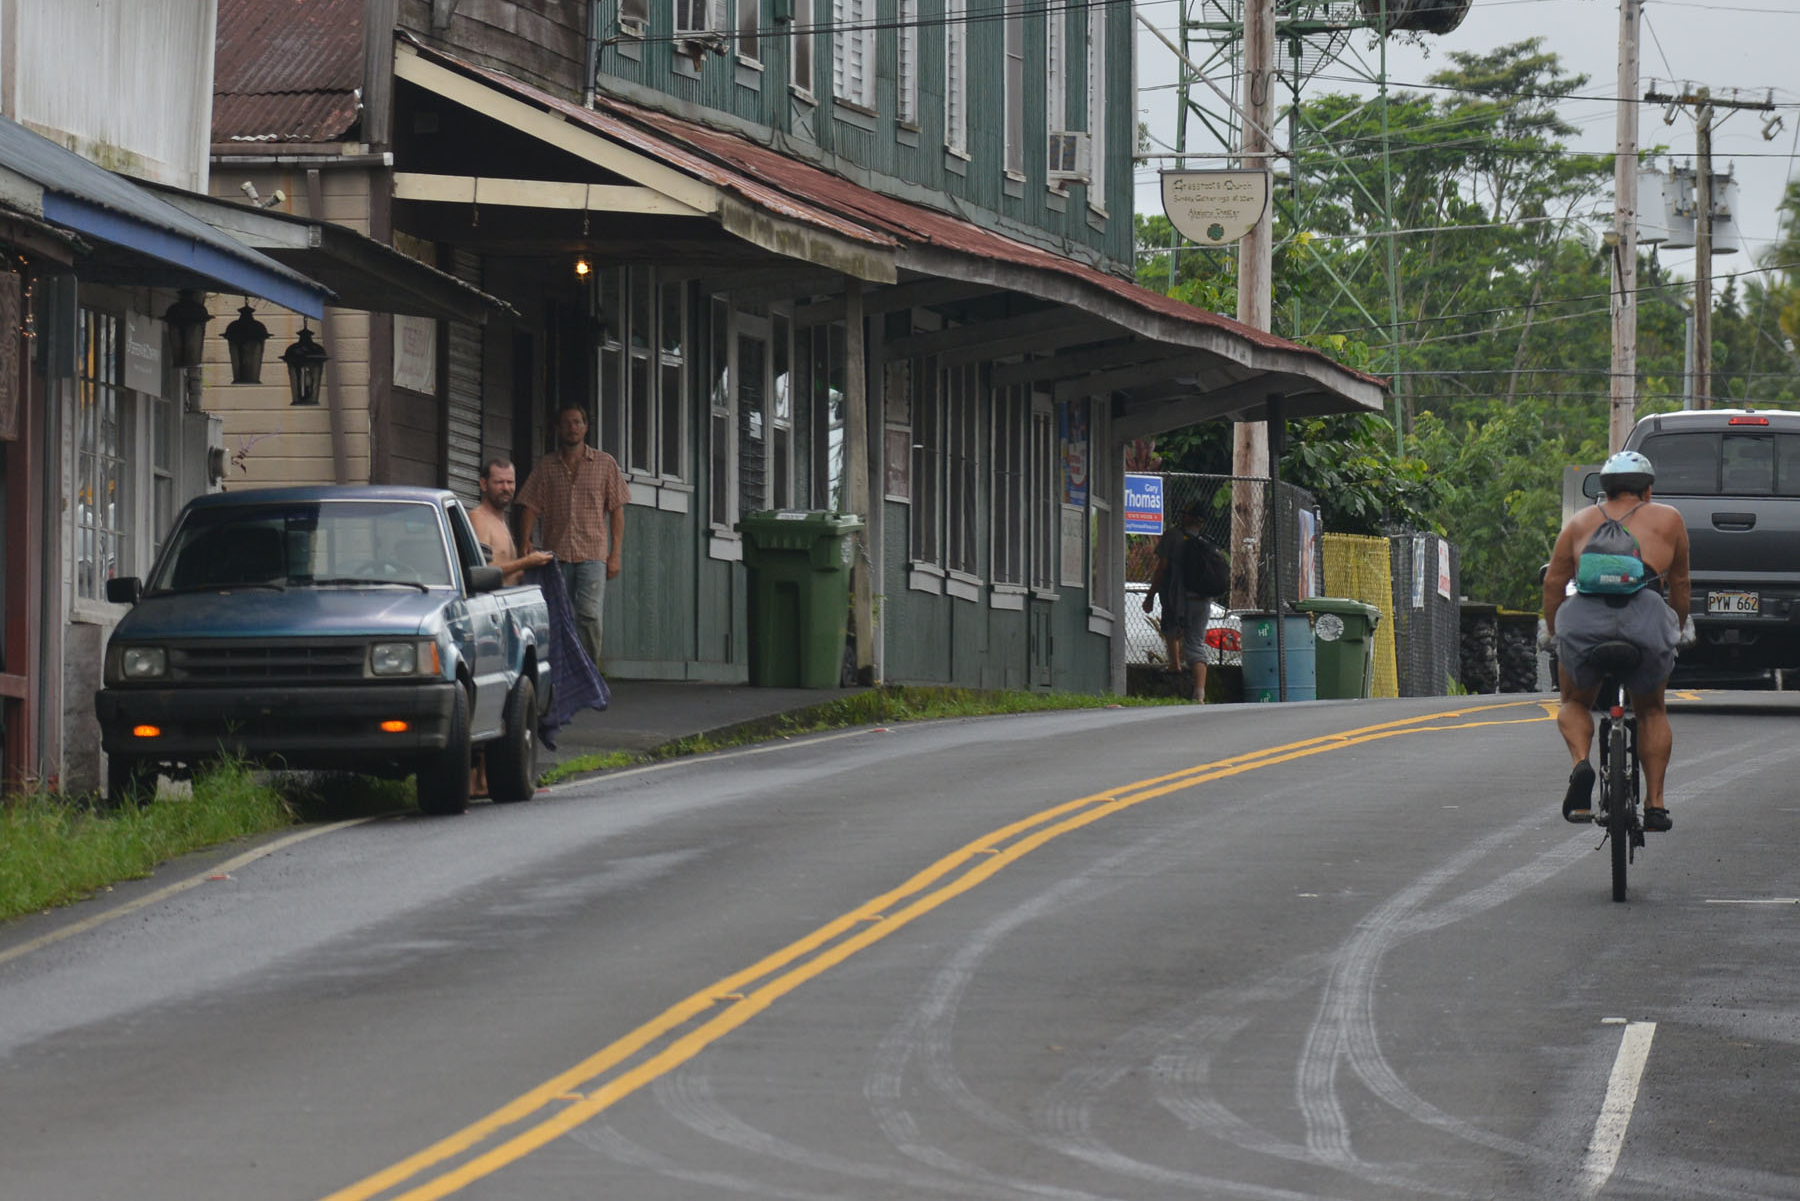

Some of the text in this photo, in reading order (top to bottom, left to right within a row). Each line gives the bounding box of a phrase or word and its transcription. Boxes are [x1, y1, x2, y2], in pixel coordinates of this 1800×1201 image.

[1124, 488, 1161, 509] Thomas
[1708, 596, 1758, 611] PYW 662
